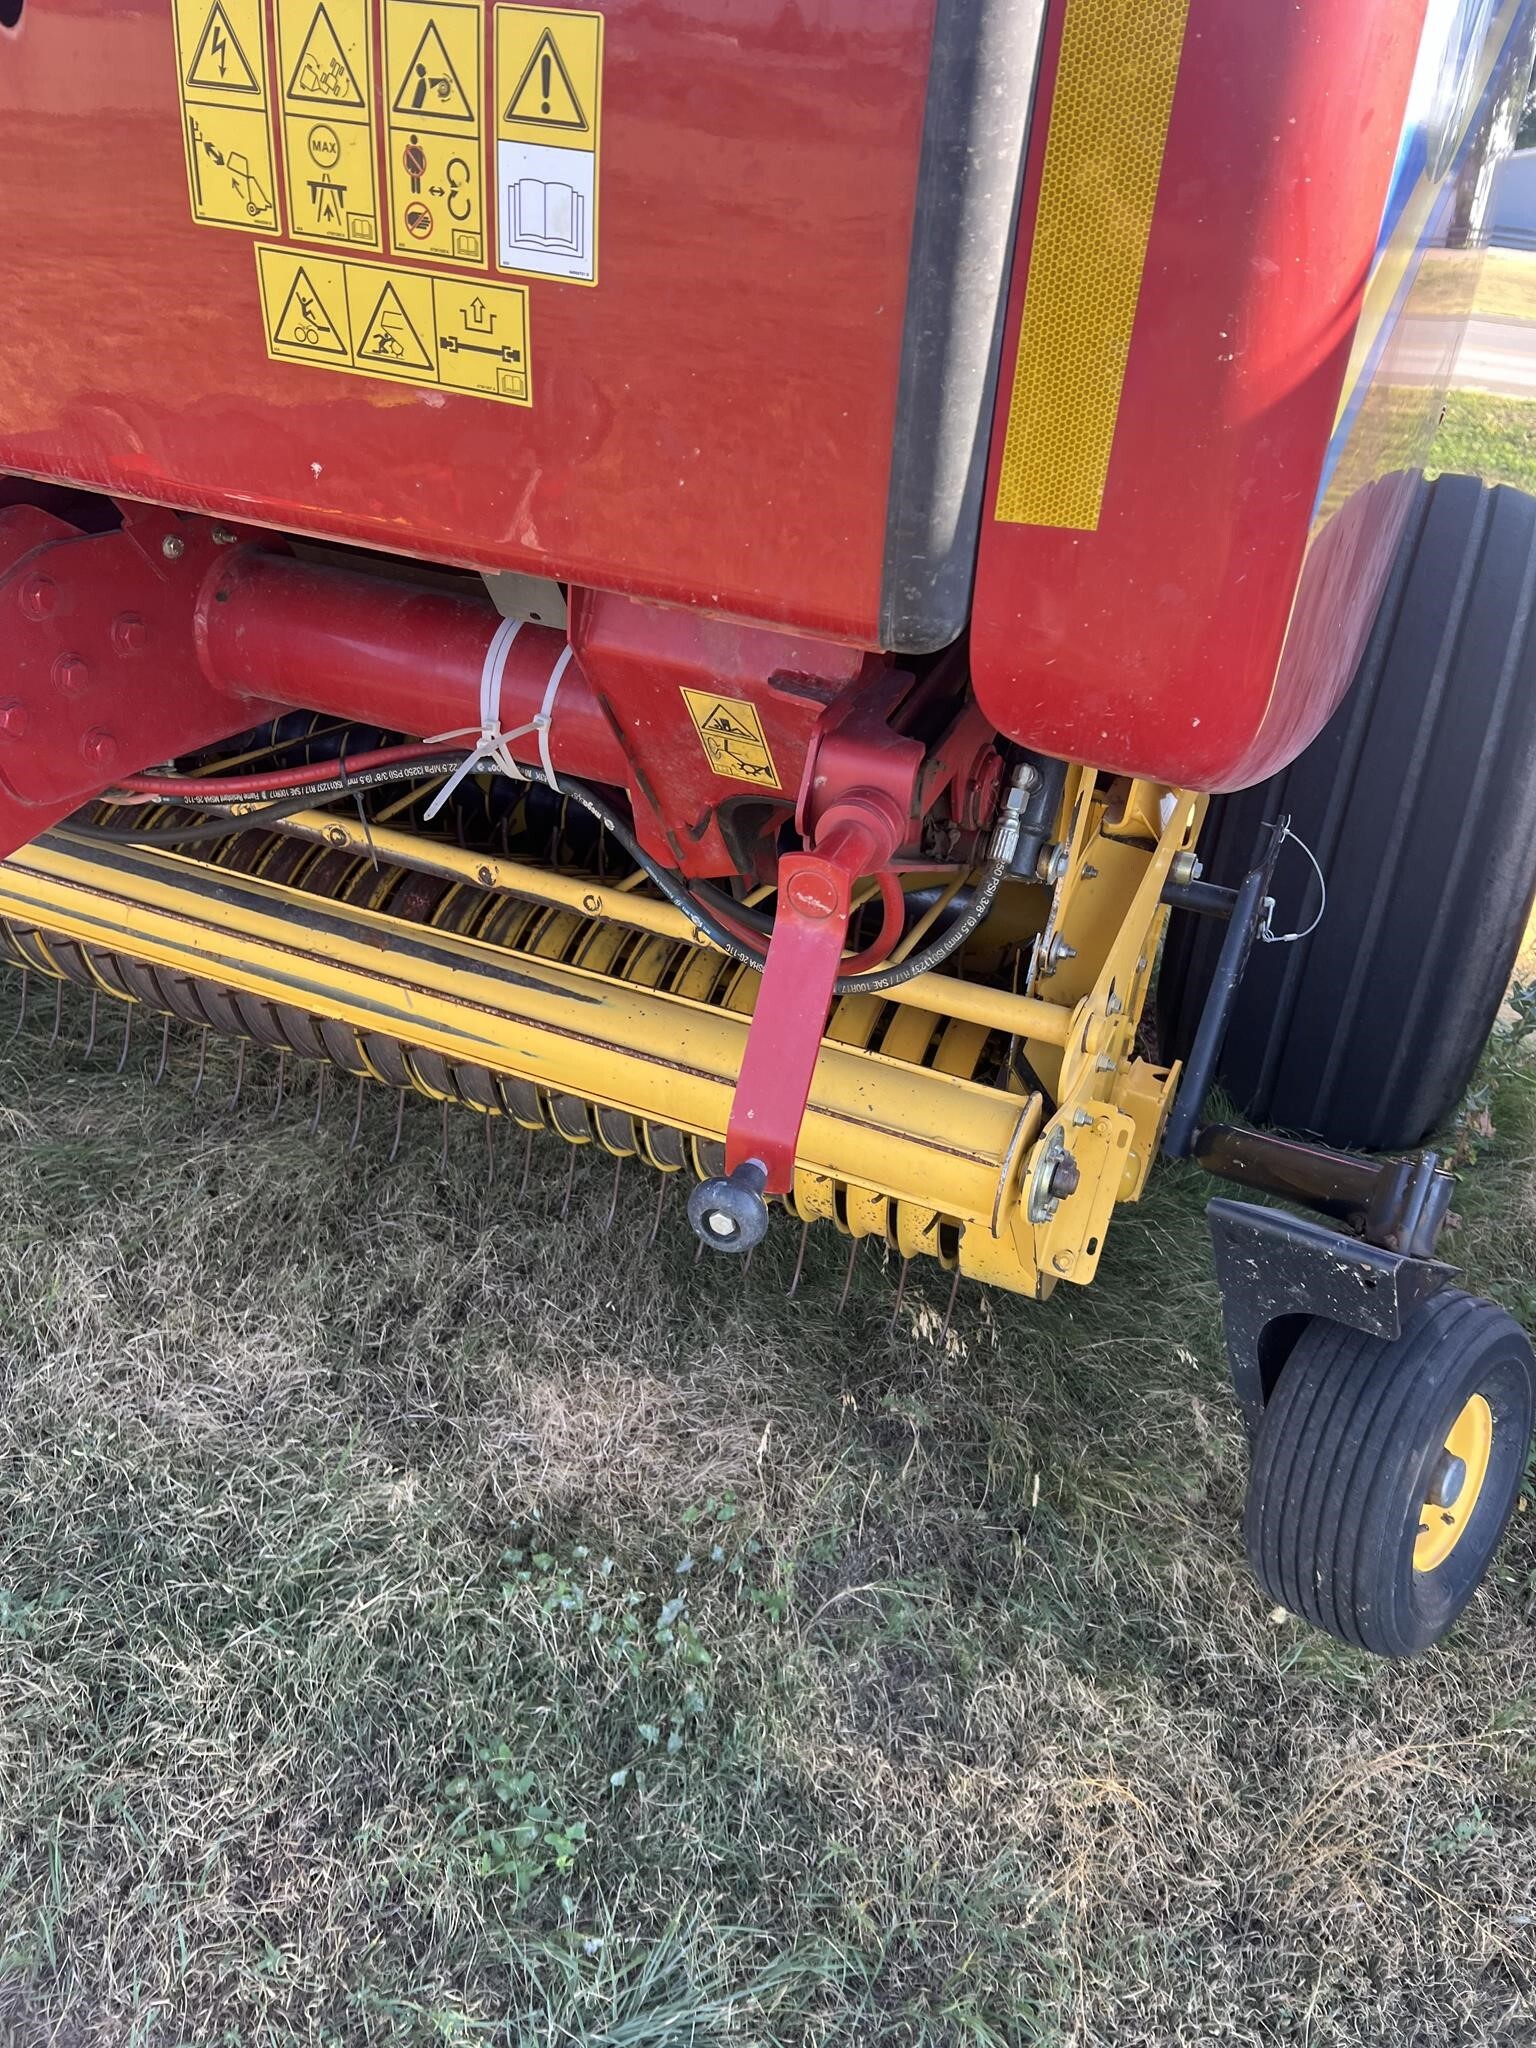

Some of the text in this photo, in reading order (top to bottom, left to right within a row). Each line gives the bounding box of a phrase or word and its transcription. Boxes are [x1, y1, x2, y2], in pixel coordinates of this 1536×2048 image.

[312, 140, 337, 154] MAX
[404, 766, 424, 776] (3250
[424, 764, 442, 774] MPa
[442, 763, 458, 772] 22.5
[359, 775, 373, 784] (9.5
[374, 772, 388, 782] 3/8"
[388, 769, 404, 779] PSI)
[290, 787, 301, 796] SAE
[305, 786, 317, 794] R17
[317, 780, 343, 793] ISO11237
[183, 795, 204, 804] 2G-11C
[269, 789, 289, 799] 100R17
[984, 877, 1000, 898] PSI)
[976, 896, 991, 918] 3/8"
[960, 915, 977, 935] (9.5
[943, 932, 963, 951] mm)
[725, 943, 750, 965] 2G-11C
[911, 950, 946, 974] ISO11237
[895, 968, 912, 982] R17
[841, 982, 871, 993] 100R17
[872, 977, 890, 990] SAE
